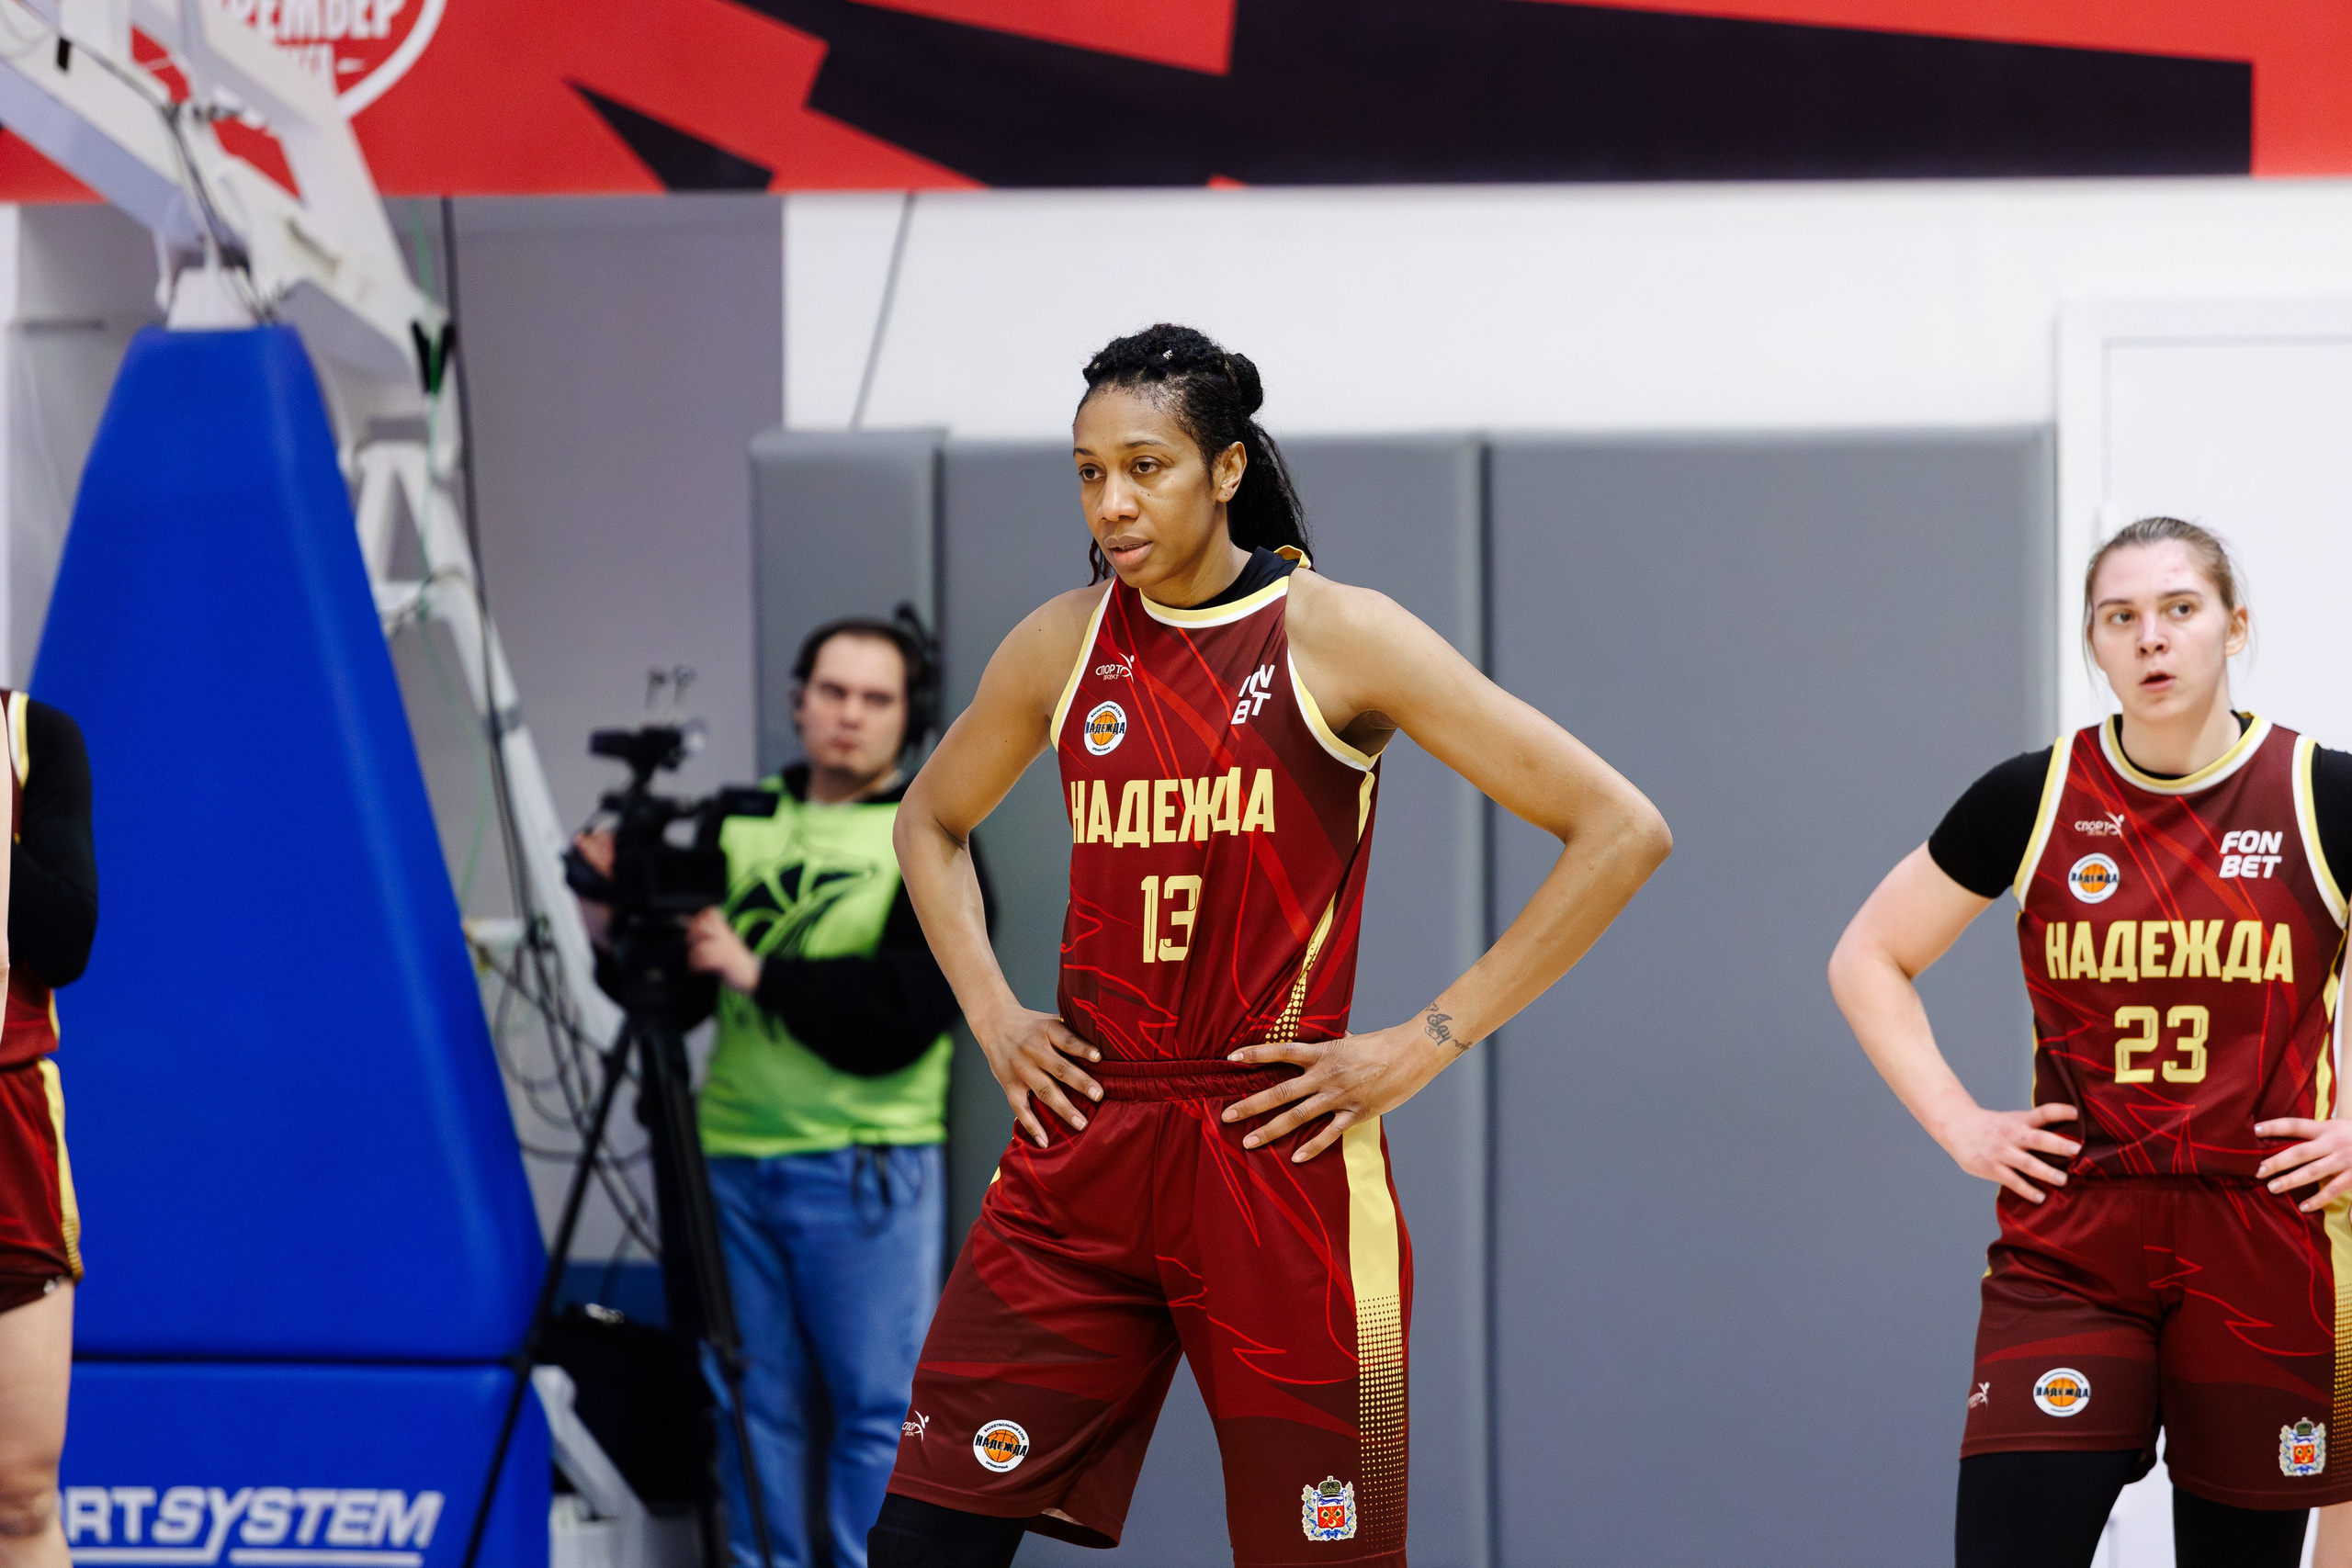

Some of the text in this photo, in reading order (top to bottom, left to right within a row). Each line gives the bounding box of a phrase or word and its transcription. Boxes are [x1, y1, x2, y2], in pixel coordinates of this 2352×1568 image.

[1231, 691, 1272, 725] BT
[1069, 766, 1275, 849] НАДЕЖДА
[2219, 829, 2283, 854] FON
[2219, 854, 2282, 879] BET
[1140, 874, 1203, 964] 13
[2045, 919, 2294, 984] НАДЕЖДА
[2114, 1005, 2210, 1084] 23
[975, 1434, 1028, 1456] НАДЕЖДА
[61, 1485, 446, 1551] RTSYSTEM
